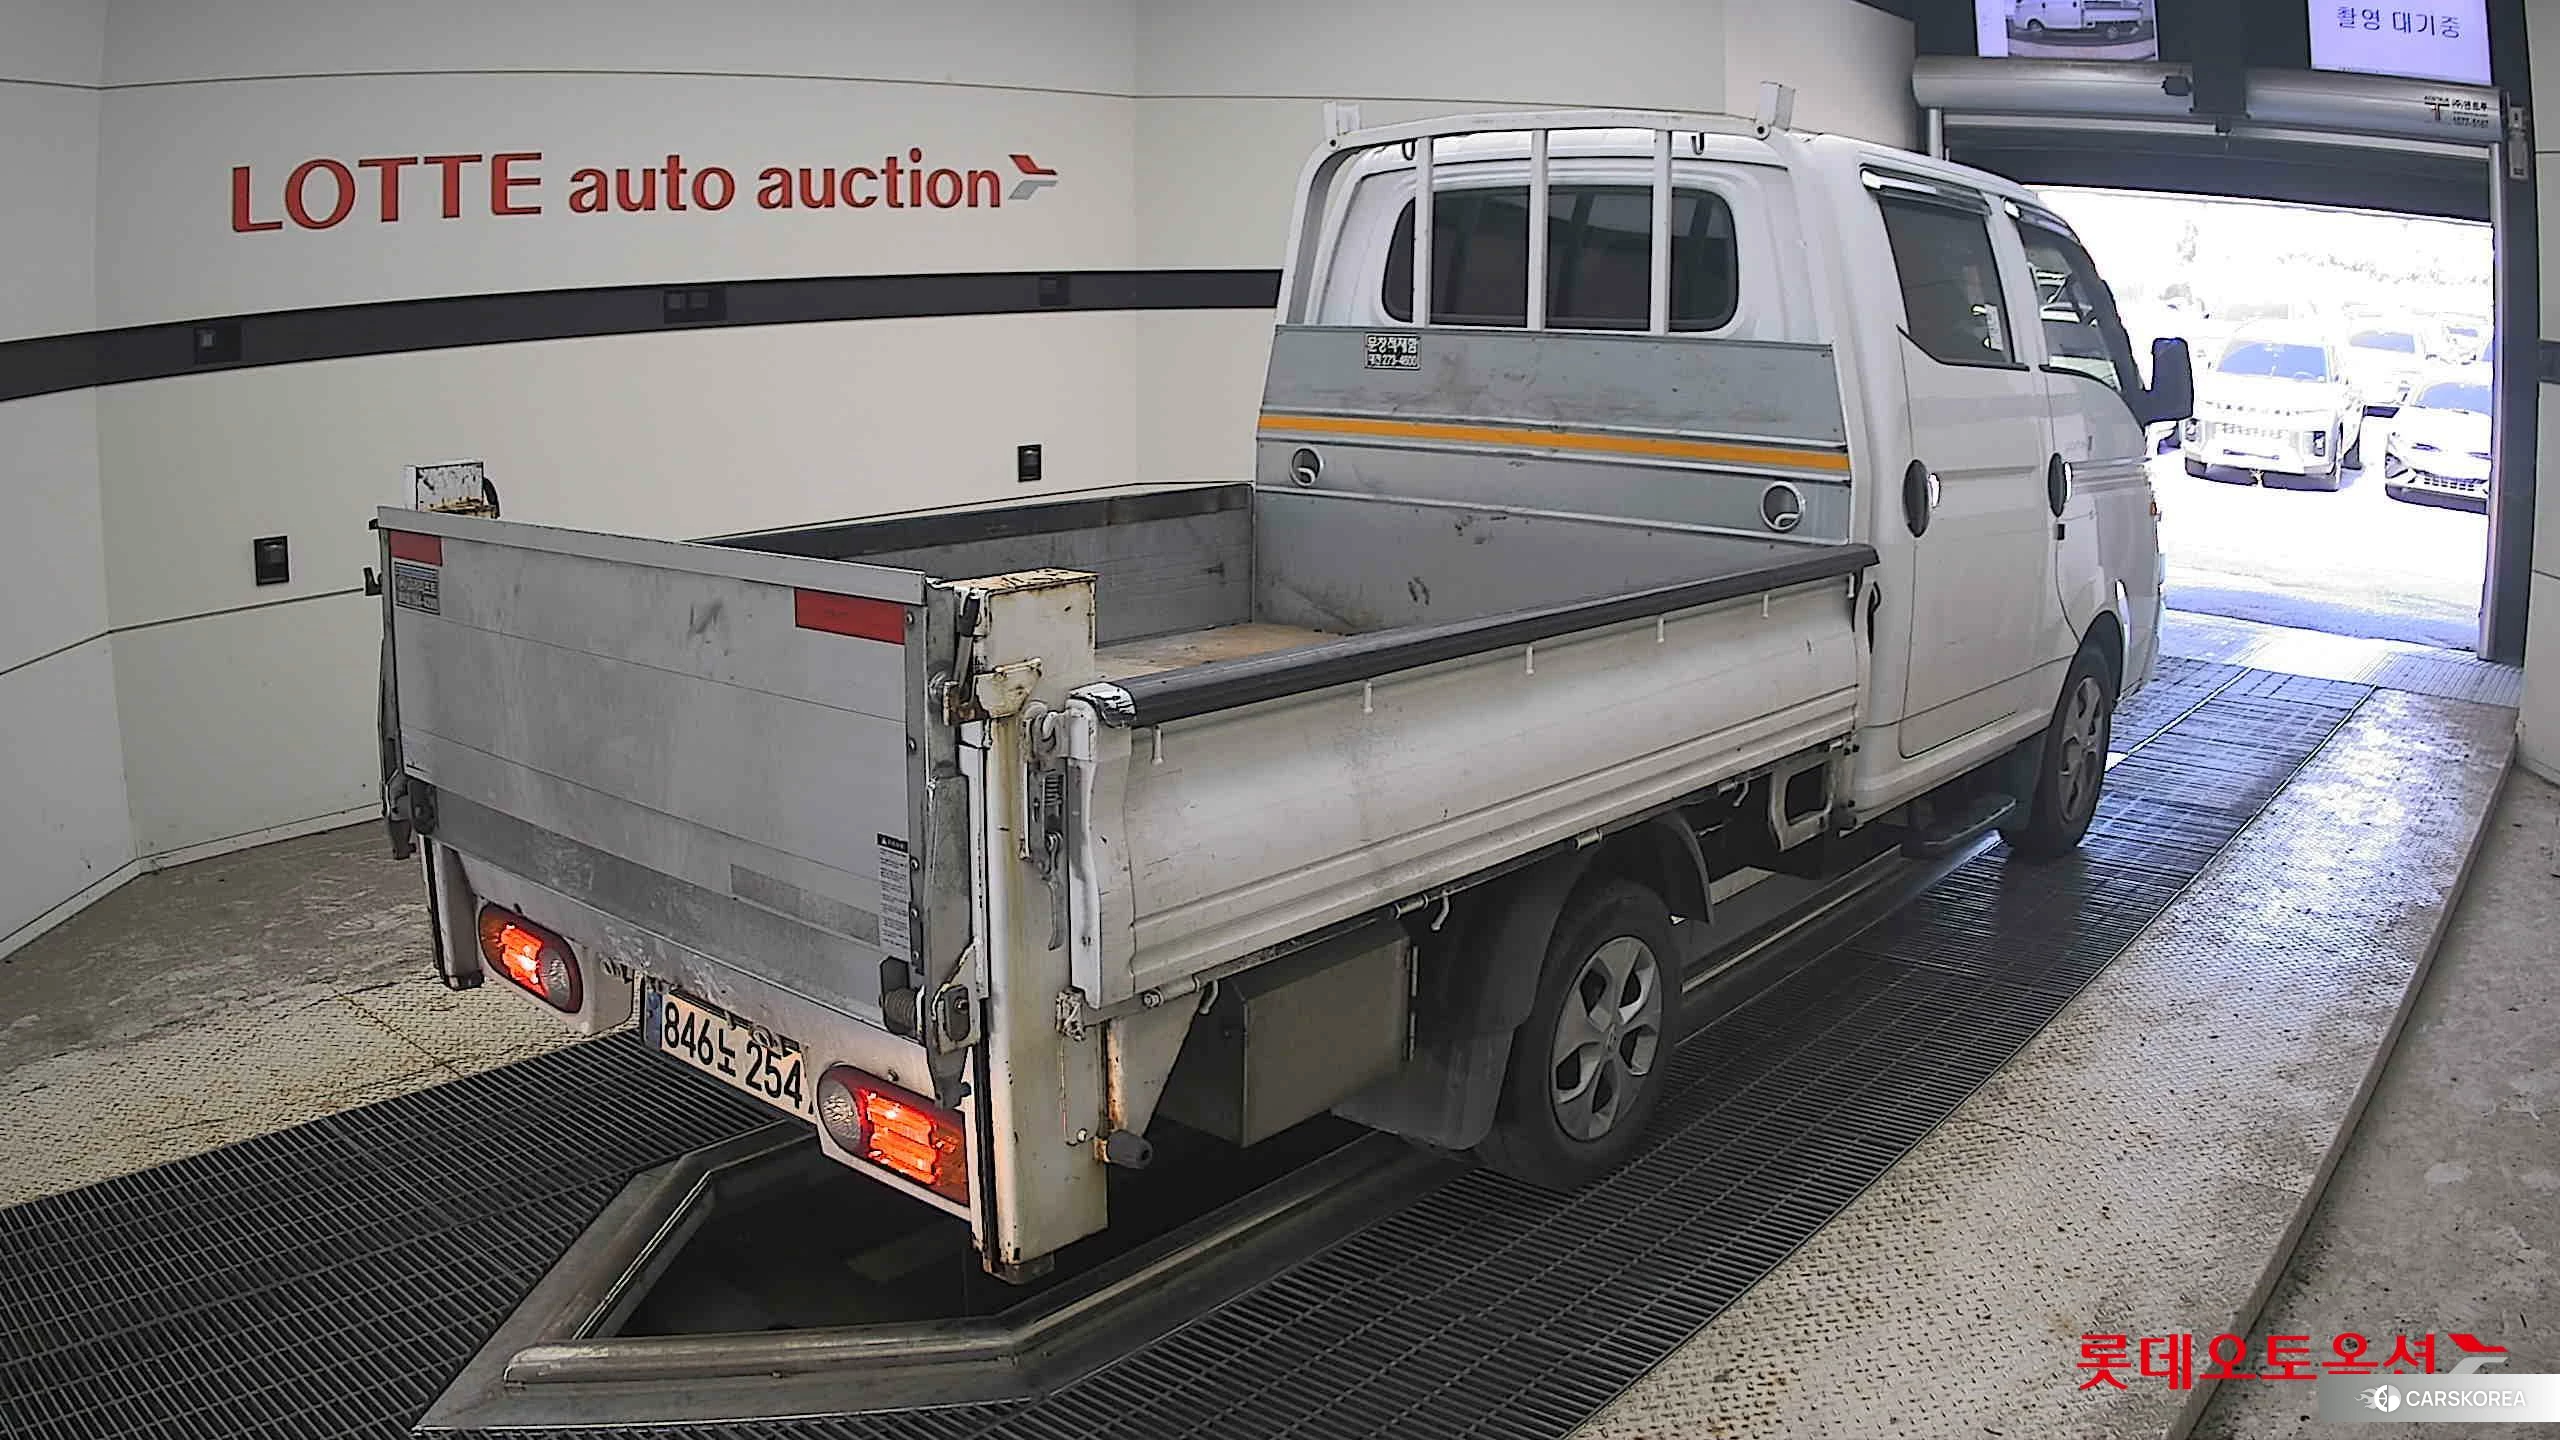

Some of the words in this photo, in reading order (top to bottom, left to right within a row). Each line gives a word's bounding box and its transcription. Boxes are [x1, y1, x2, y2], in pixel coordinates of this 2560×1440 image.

[2337, 6, 2381, 31] 촬영
[2392, 11, 2460, 39] 대기중
[232, 152, 543, 232] LOTTE
[568, 154, 736, 213] auto
[756, 147, 1002, 210] auction
[664, 1001, 737, 1078] 846노
[745, 1040, 803, 1109] 254
